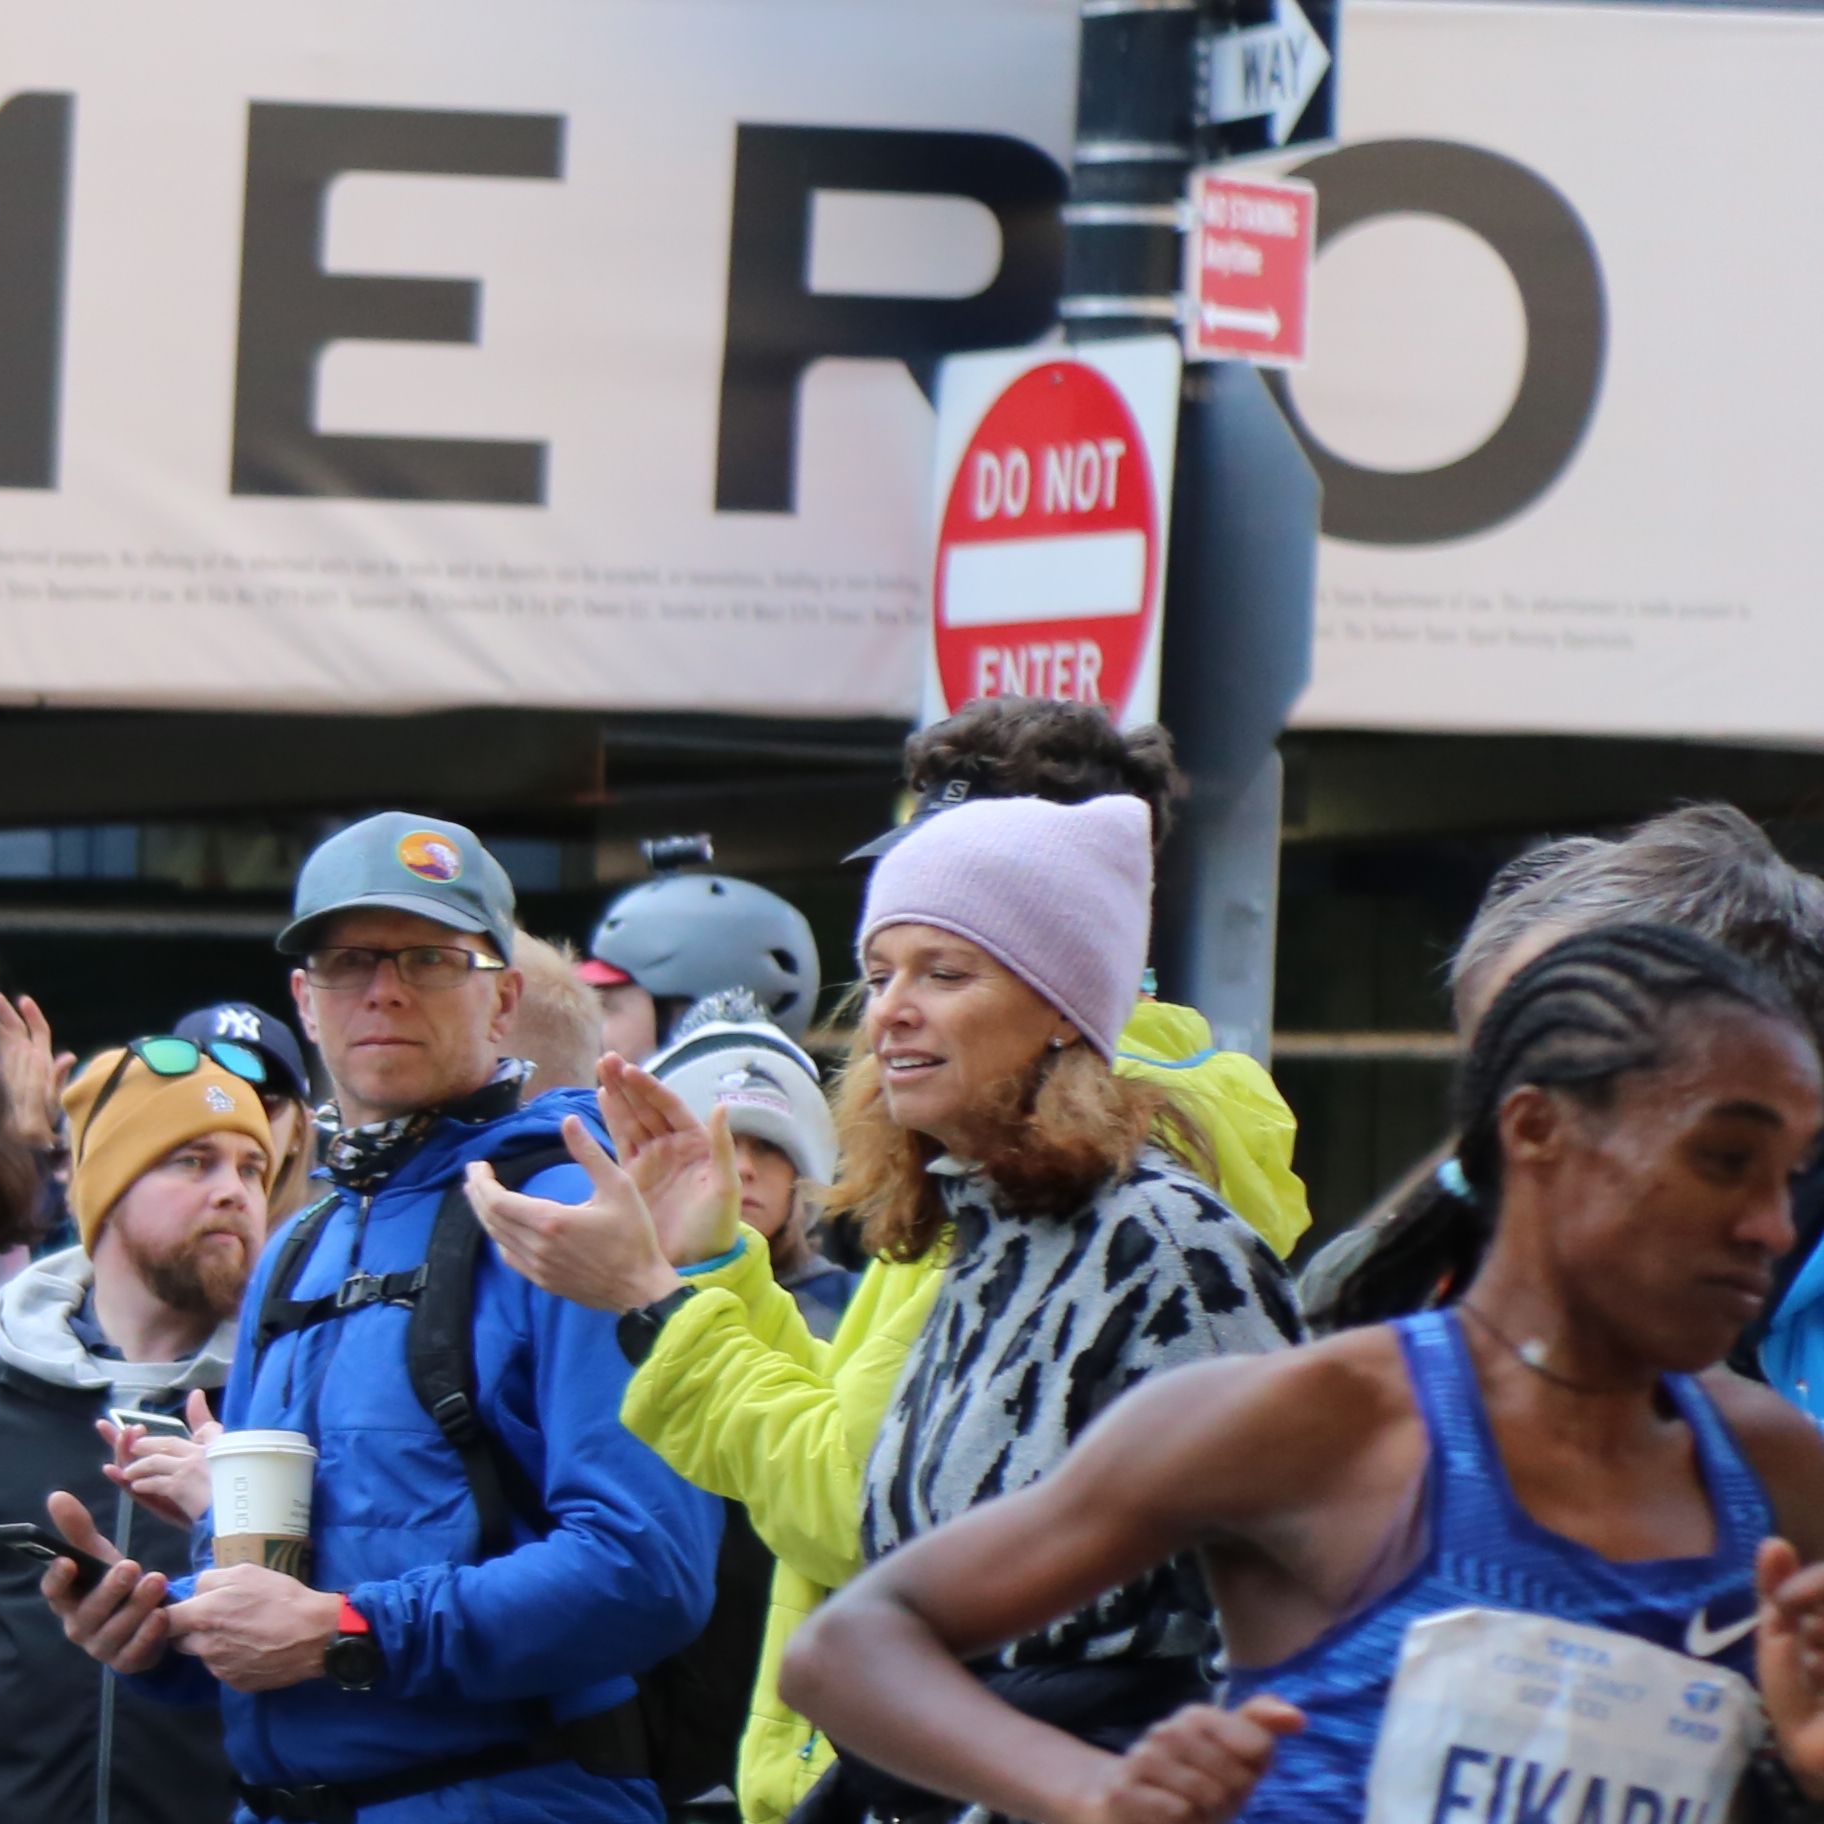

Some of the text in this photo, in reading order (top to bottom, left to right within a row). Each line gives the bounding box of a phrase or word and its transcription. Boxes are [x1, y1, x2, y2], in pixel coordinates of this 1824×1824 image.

[1243, 33, 1305, 105] WAY
[973, 437, 1127, 521] DO NOT
[976, 637, 1103, 704] ENTER
[217, 1008, 261, 1040] NY
